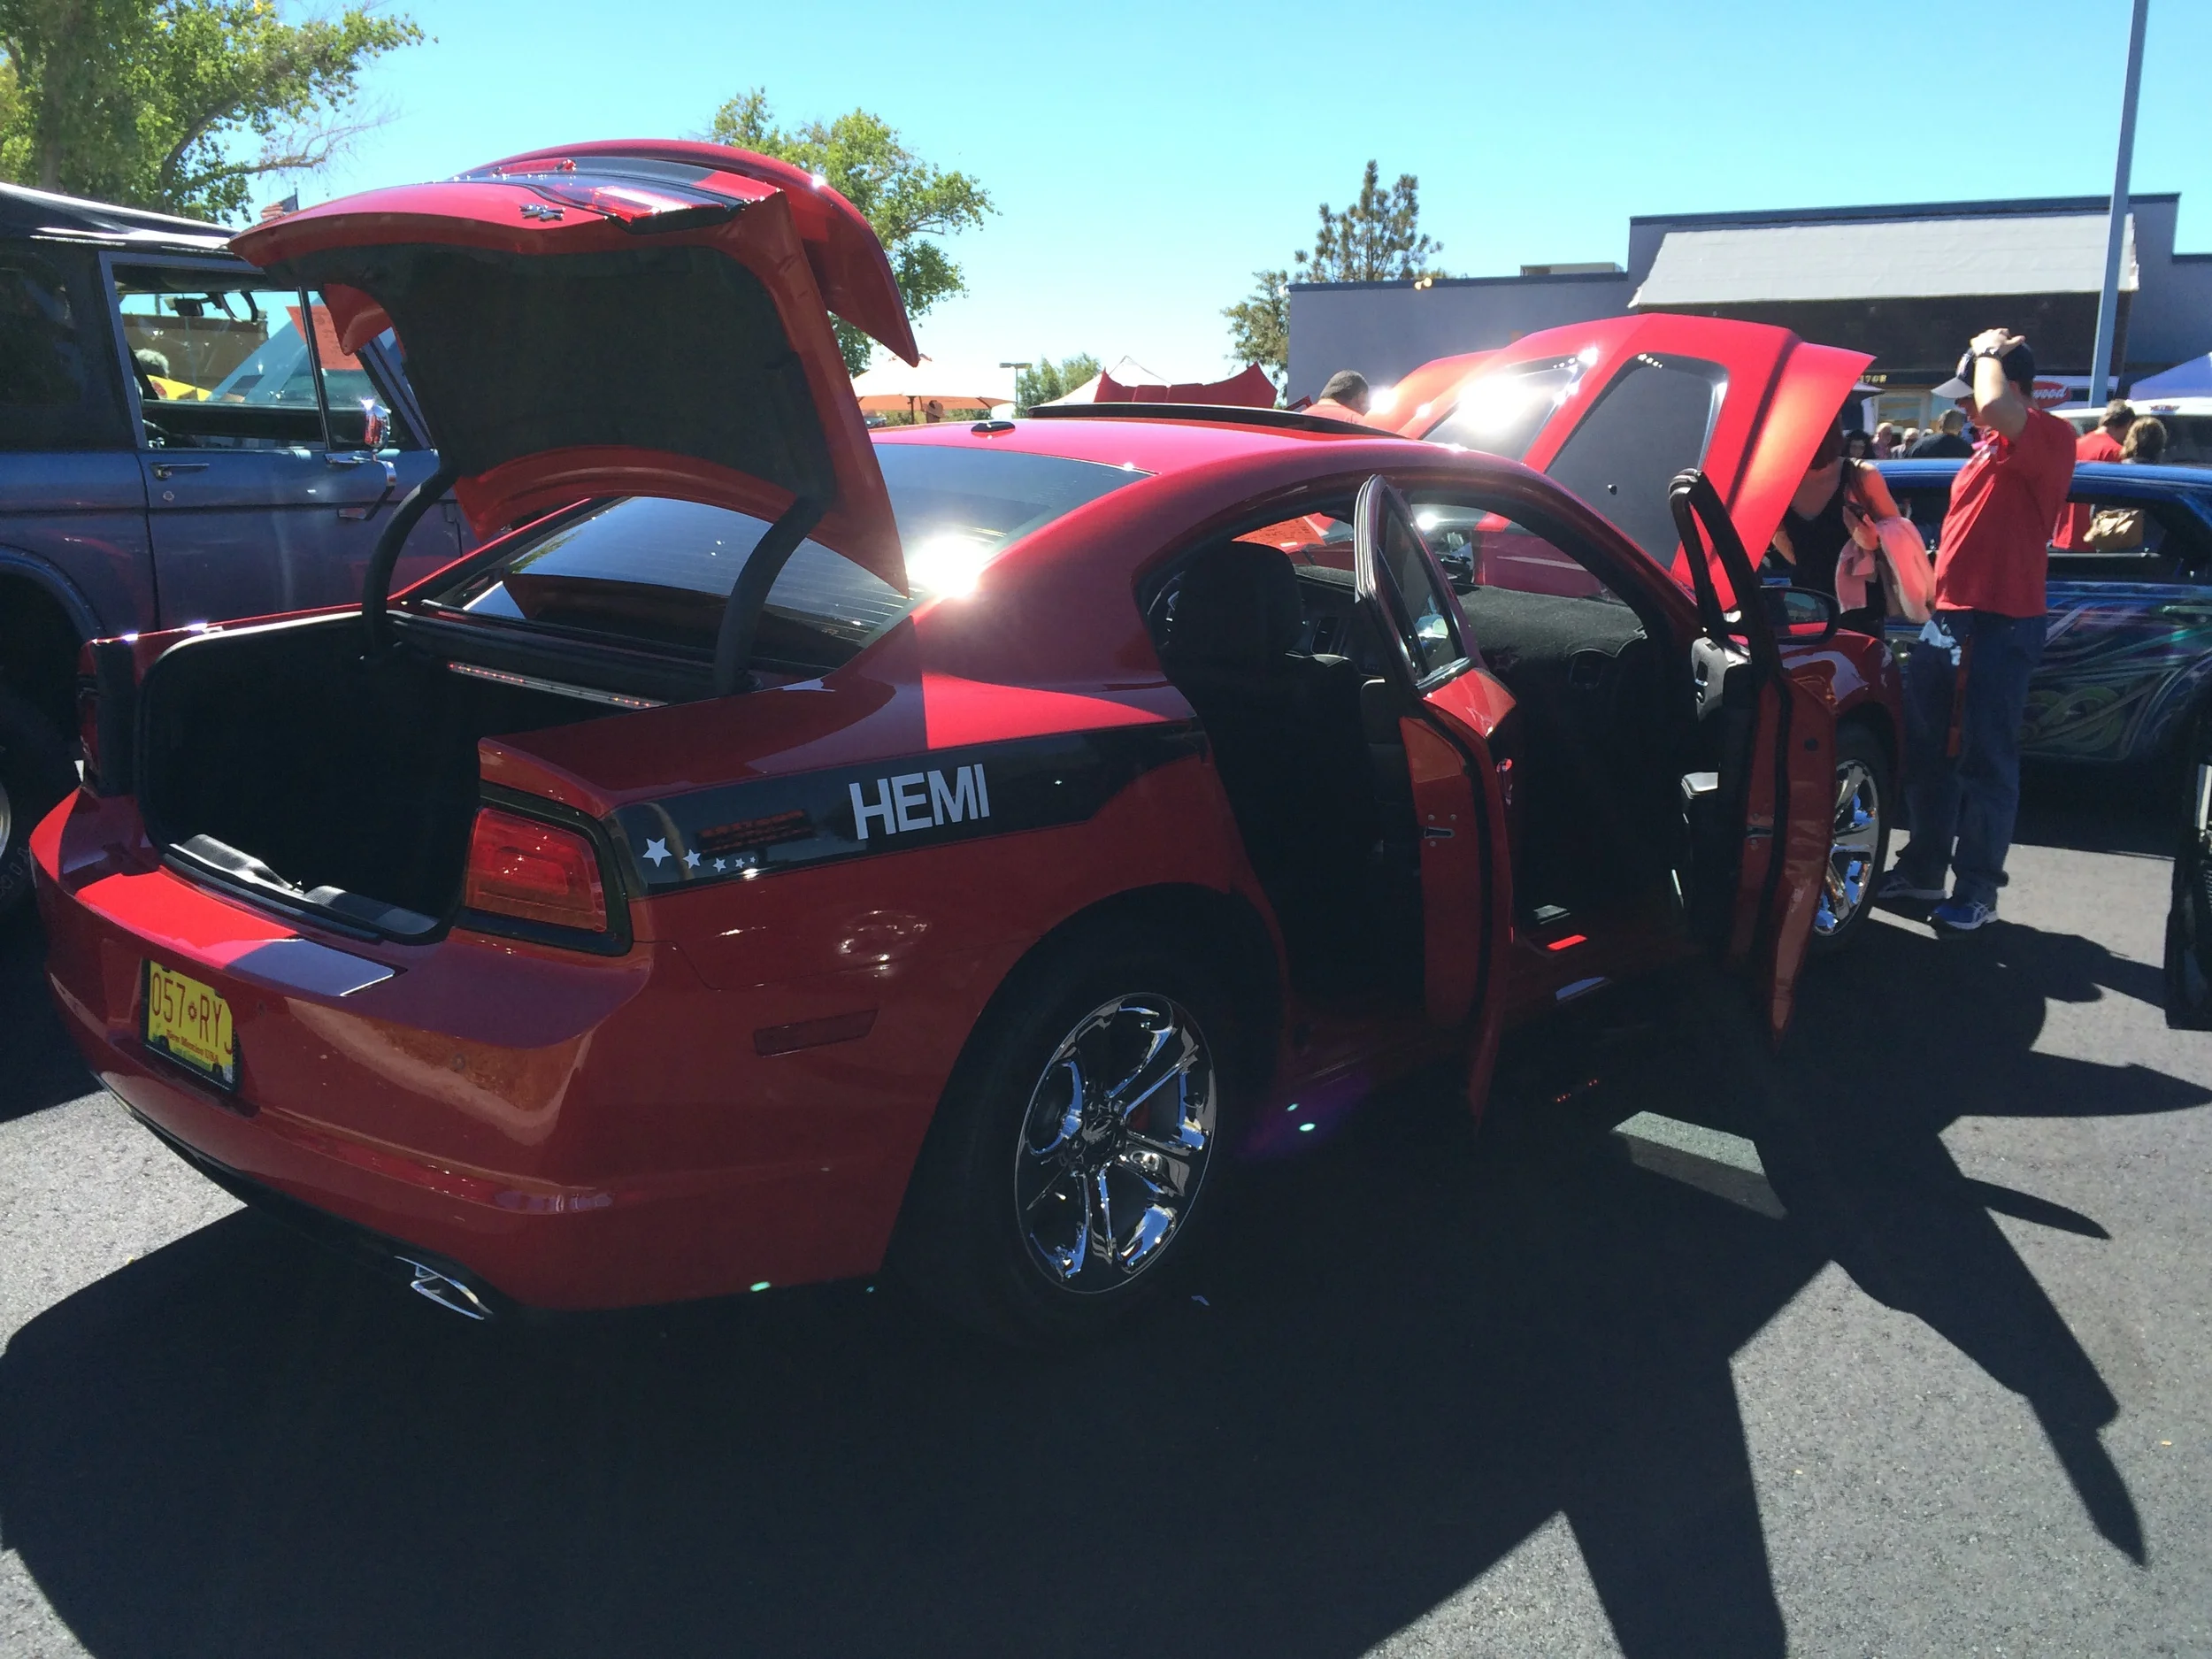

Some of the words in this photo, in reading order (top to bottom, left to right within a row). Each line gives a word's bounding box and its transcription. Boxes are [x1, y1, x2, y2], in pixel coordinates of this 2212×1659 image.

[2032, 384, 2068, 399] wood
[849, 764, 990, 840] HEMI
[152, 973, 186, 1028] 057
